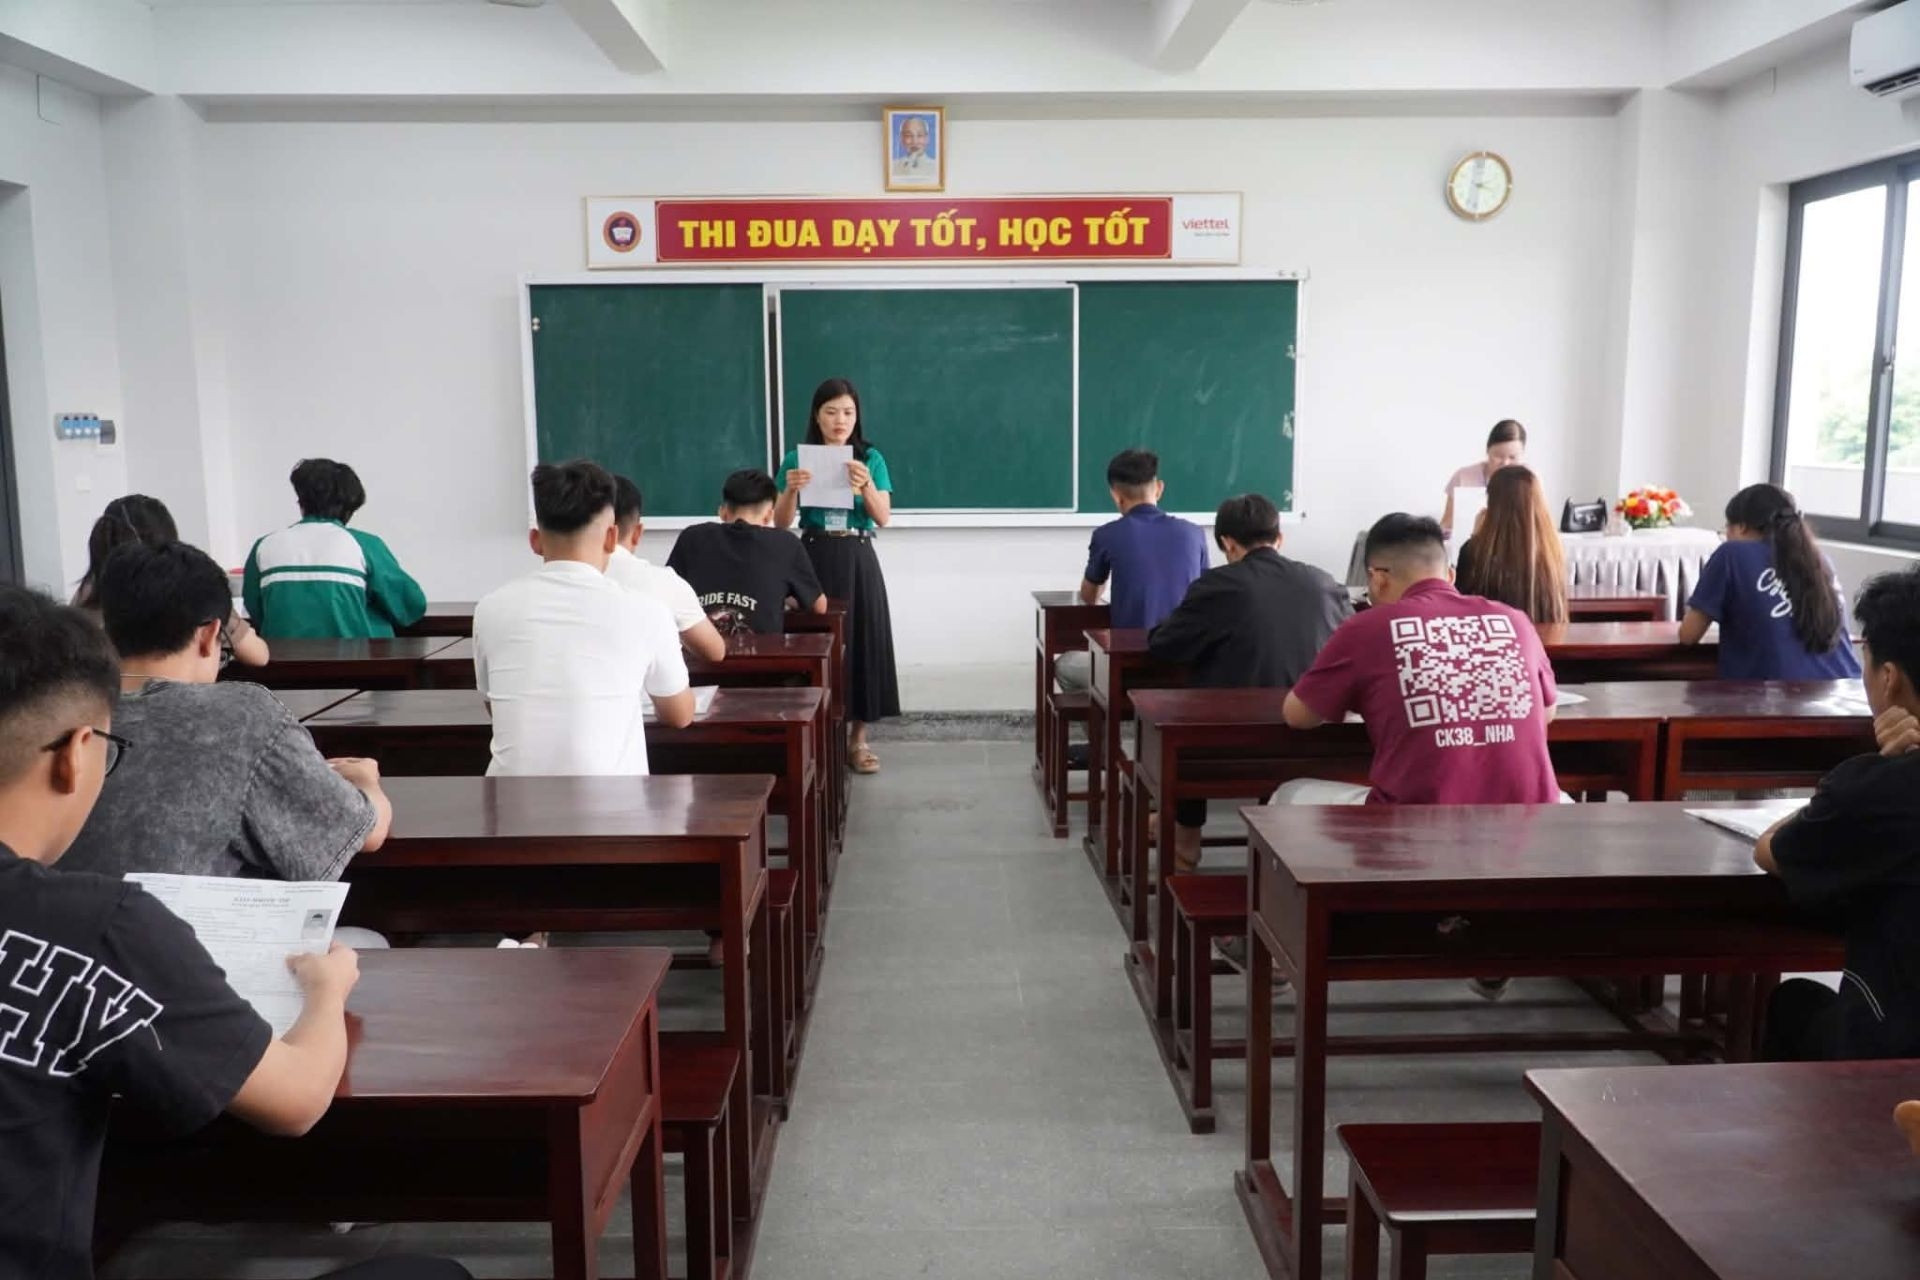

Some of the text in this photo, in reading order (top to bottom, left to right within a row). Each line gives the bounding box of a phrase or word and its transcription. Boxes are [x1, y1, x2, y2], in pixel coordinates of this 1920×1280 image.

[678, 207, 1150, 253] THI ĐUA DẠY TỐT, HỌC TỐT
[1182, 218, 1229, 230] viettel
[727, 592, 758, 611] FAST
[1435, 725, 1516, 748] CK38_NHA
